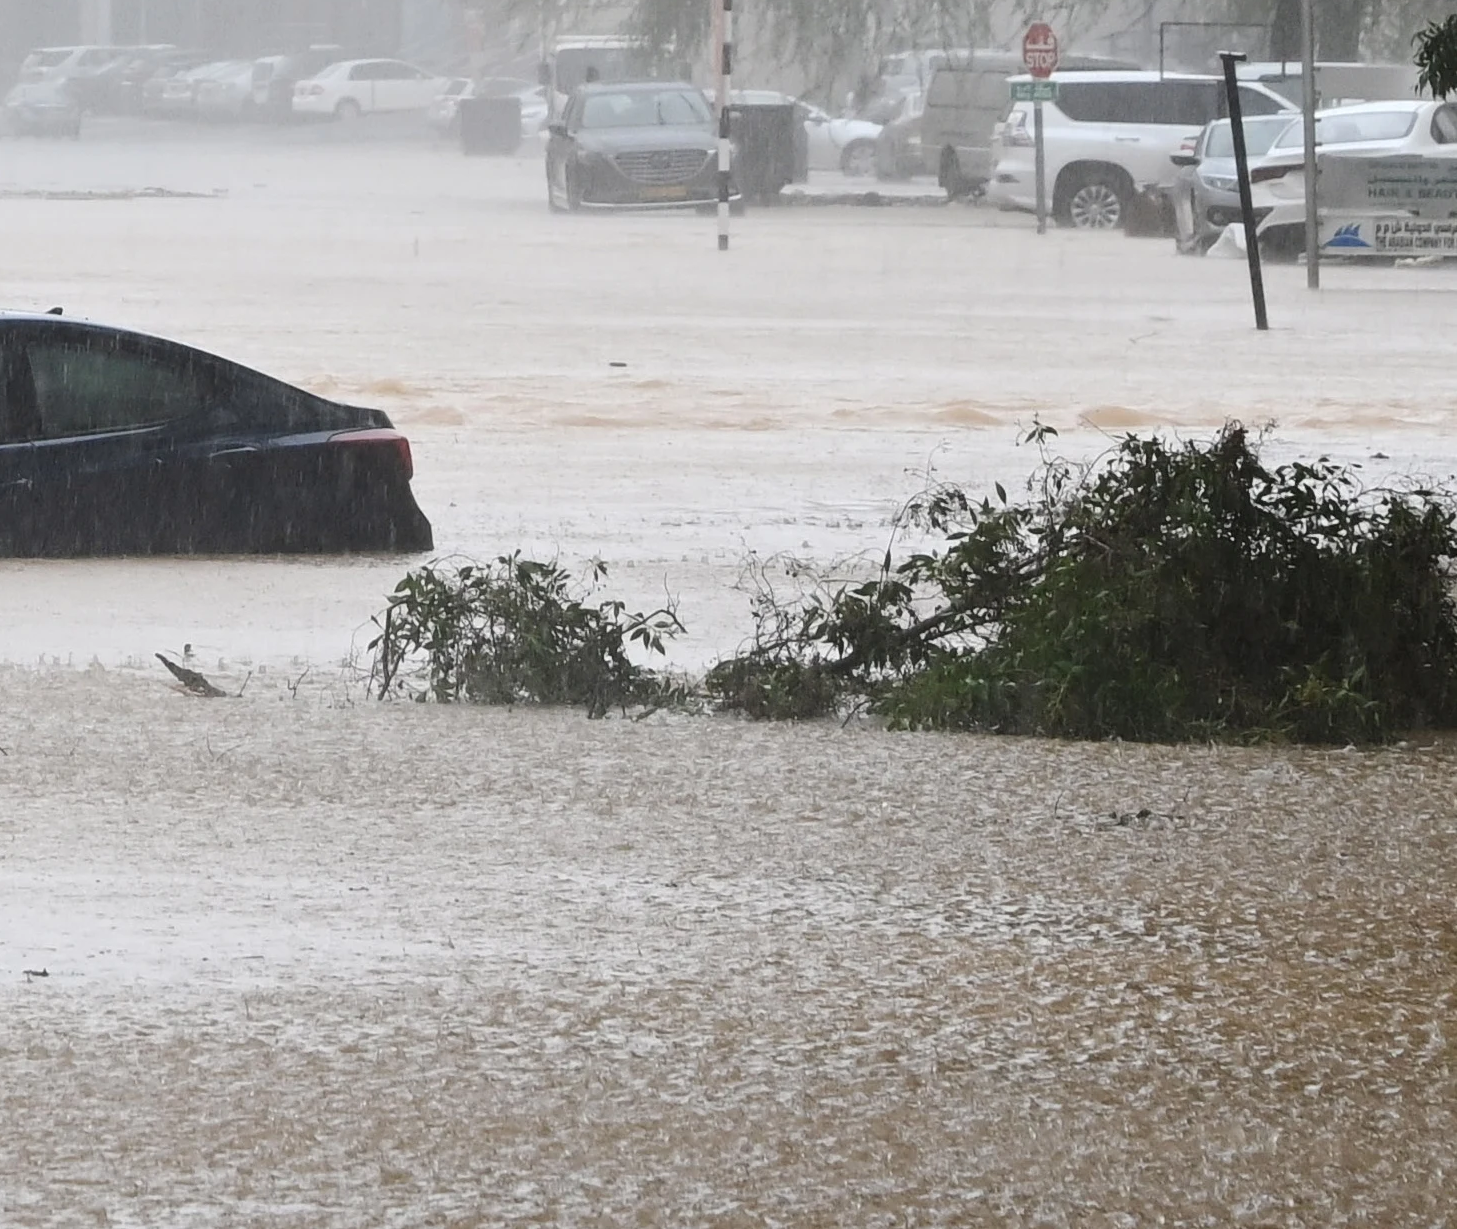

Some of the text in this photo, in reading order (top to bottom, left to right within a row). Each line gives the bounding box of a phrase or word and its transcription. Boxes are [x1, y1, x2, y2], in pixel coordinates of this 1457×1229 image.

[1026, 52, 1055, 68] STOP
[1368, 187, 1399, 198] HAIR
[1415, 236, 1442, 248] COMPANY
